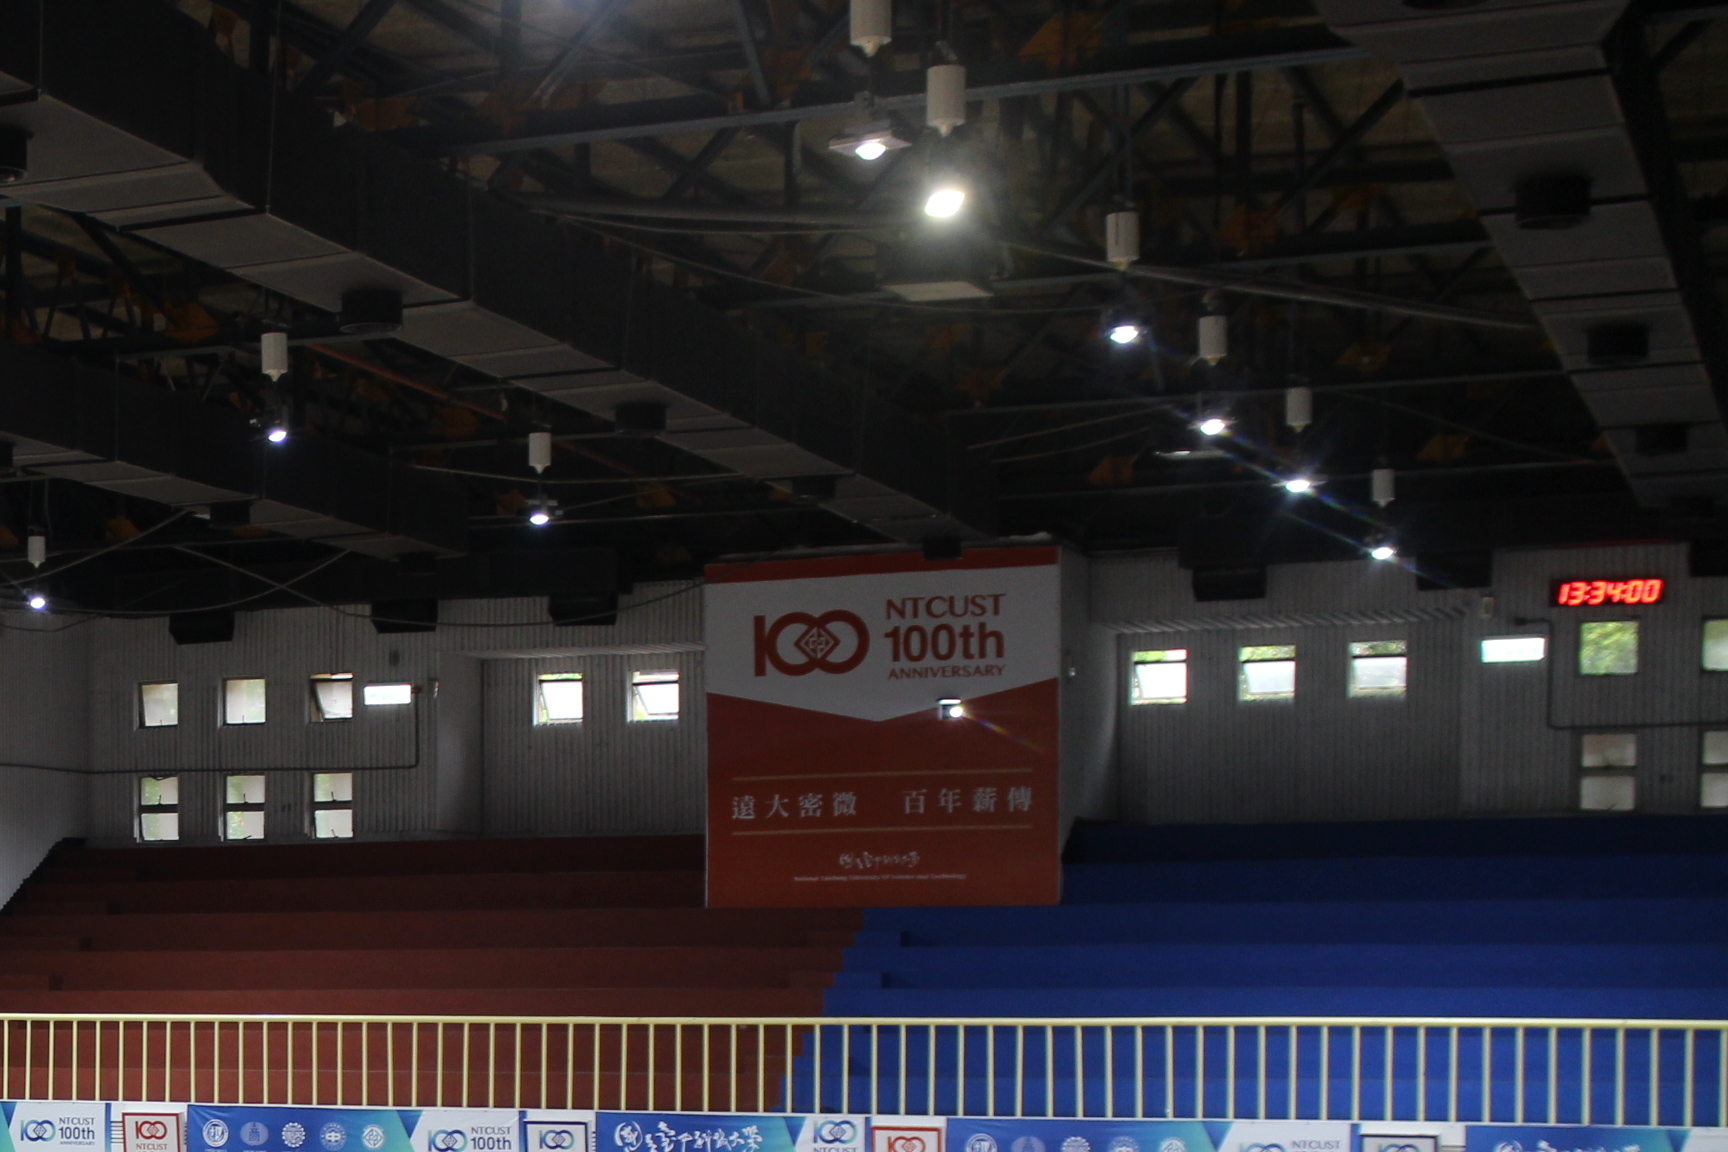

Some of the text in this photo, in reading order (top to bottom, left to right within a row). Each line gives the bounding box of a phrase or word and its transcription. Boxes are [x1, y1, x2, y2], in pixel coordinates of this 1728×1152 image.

[1558, 579, 1664, 606] 13:34:00
[885, 593, 1007, 620] NTCUST
[884, 622, 1005, 662] 100th
[888, 664, 1006, 680] ANNIVERSARY
[732, 787, 1033, 820] 遠大密微 百年薪傳
[59, 1117, 95, 1126] NTCUST
[59, 1126, 95, 1140] 100th
[471, 1127, 512, 1136] NTCUST
[136, 1143, 168, 1151] NTCUST
[470, 1136, 512, 1151] 100th
[1292, 1140, 1341, 1149] NTCUST
